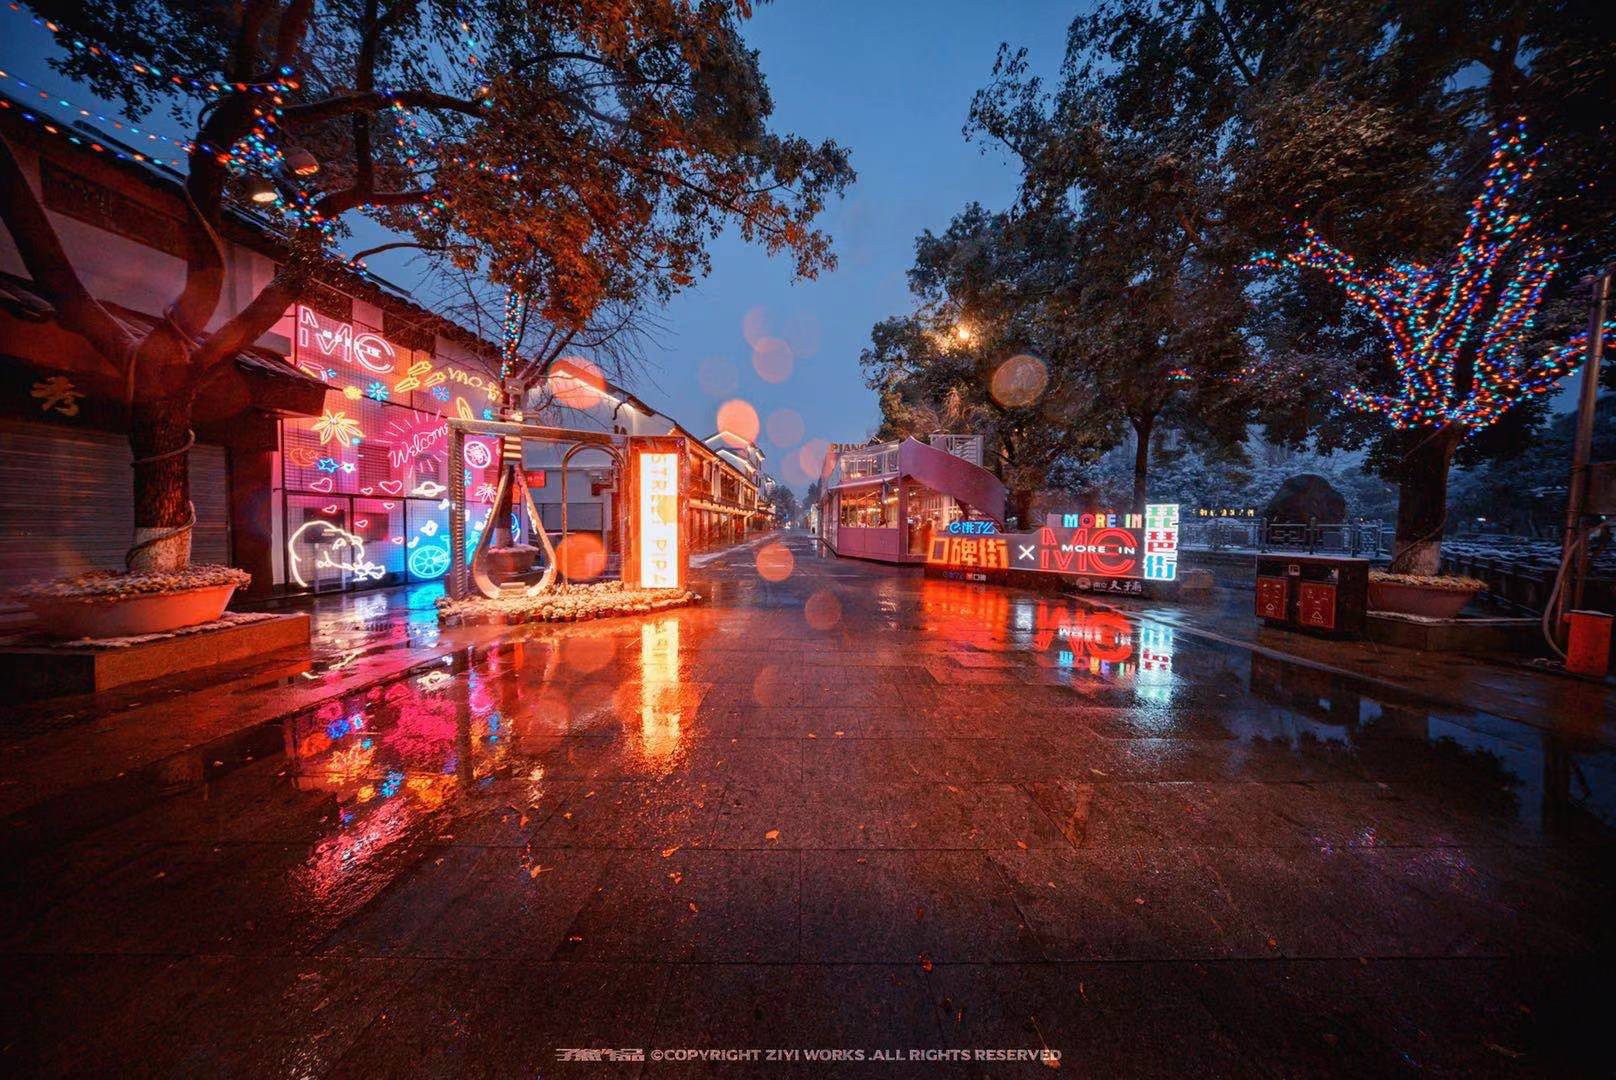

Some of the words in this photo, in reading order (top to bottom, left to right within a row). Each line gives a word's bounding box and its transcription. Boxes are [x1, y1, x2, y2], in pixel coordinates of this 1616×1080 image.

[1063, 513, 1117, 528] MORE
[1124, 513, 1143, 528] IN
[927, 536, 1009, 570] 口碑街
[1061, 544, 1107, 554] MORE
[1118, 545, 1136, 555] IN
